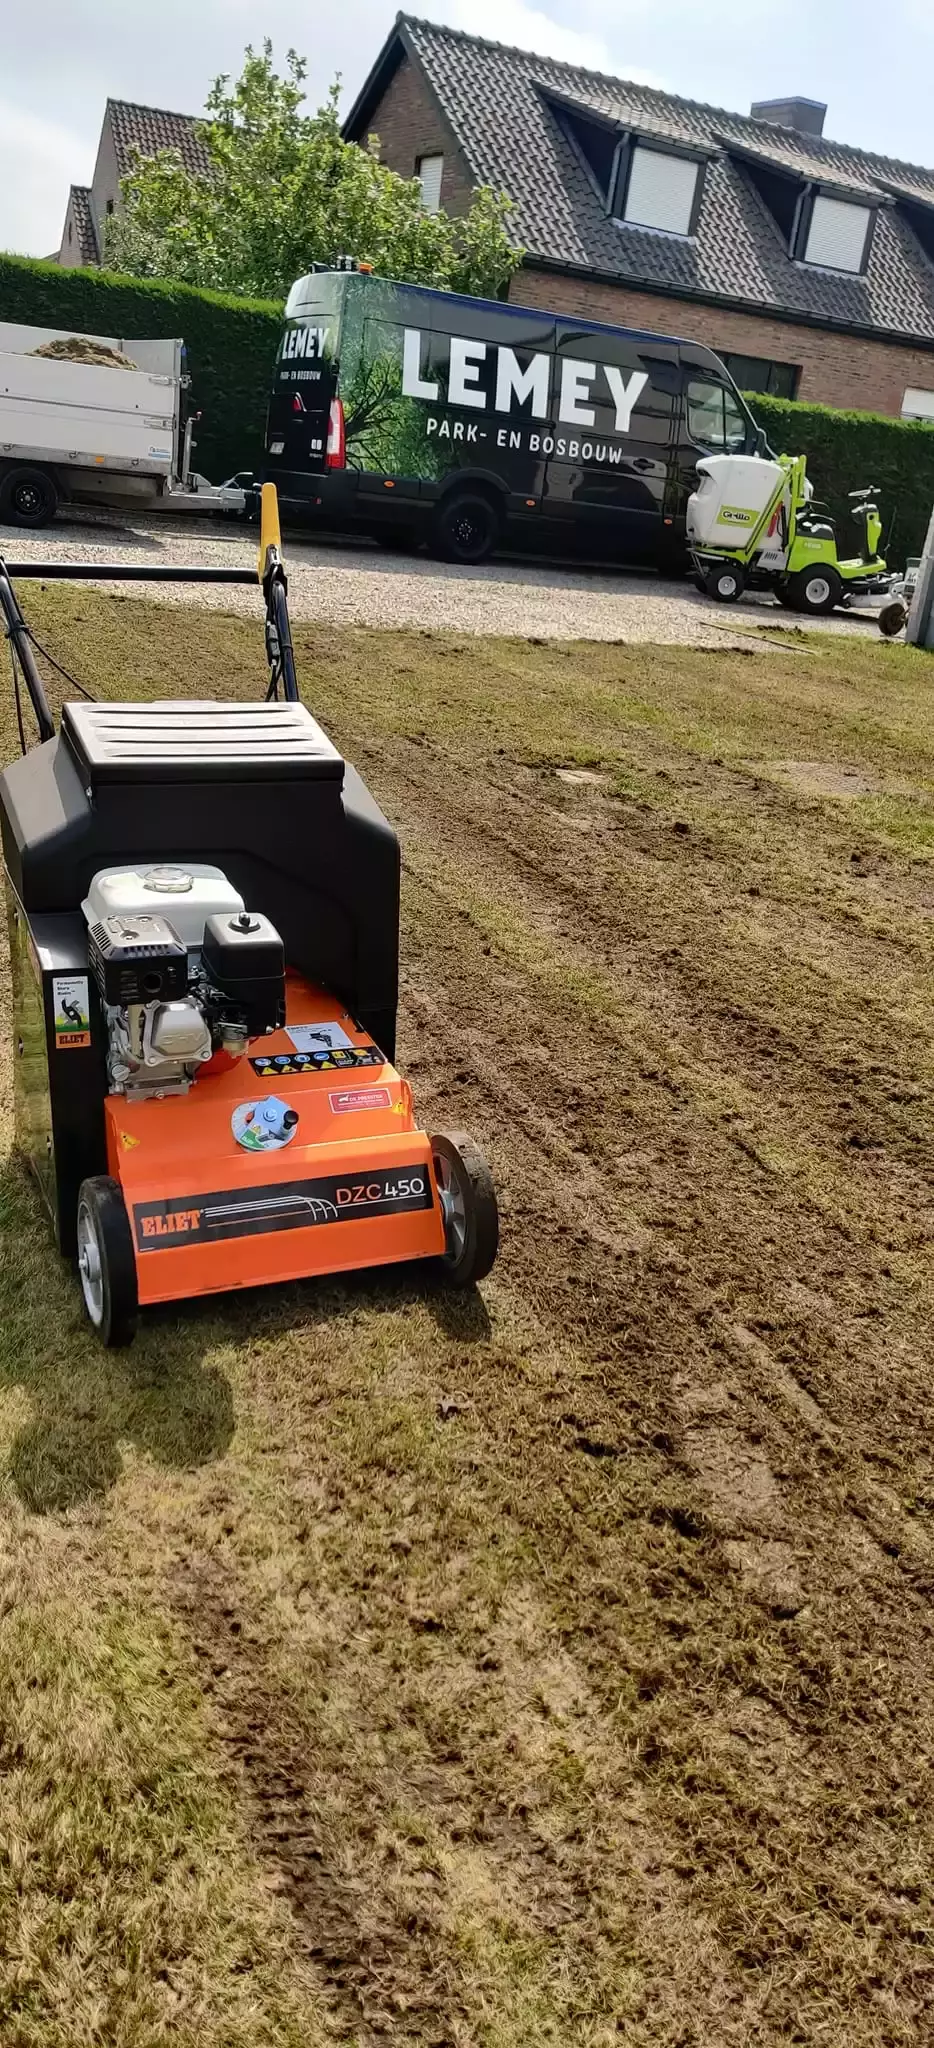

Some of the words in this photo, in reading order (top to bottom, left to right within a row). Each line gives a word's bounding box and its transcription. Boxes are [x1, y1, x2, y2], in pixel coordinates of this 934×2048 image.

[282, 327, 330, 359] LEMEY
[401, 328, 649, 432] LEMEY
[426, 418, 487, 443] PARK-
[497, 429, 521, 449] EN
[529, 433, 623, 464] BOSBOUW
[59, 1034, 85, 1045] ELIET
[336, 1183, 382, 1204] DZC
[384, 1177, 425, 1197] 450
[141, 1210, 200, 1237] ELIET
